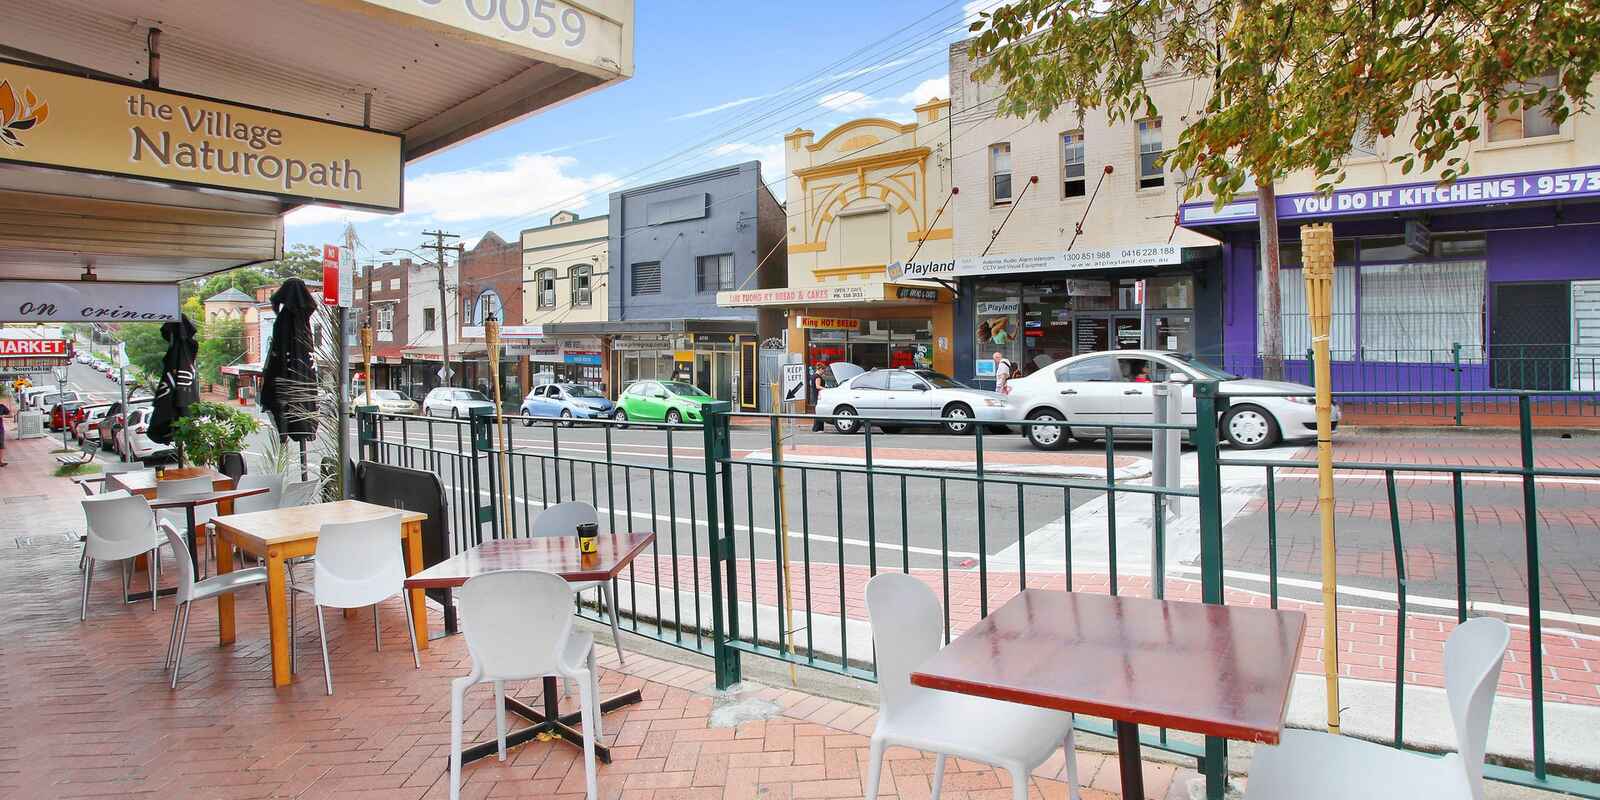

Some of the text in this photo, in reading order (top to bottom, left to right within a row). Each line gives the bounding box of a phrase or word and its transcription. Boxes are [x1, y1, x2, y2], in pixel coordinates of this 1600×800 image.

[127, 94, 283, 150] the Village
[130, 125, 363, 191] Naturopath
[1293, 170, 1600, 213] YOU DO IT KITCHENS 9573
[1121, 249, 1140, 258] 0416
[1142, 248, 1158, 257] 228
[904, 260, 956, 275] Playland
[81, 305, 174, 320] crinan
[988, 303, 1018, 312] Playland
[802, 317, 858, 328] King HOT BREAD
[786, 366, 801, 374] KEEP
[787, 374, 802, 382] LEFT
